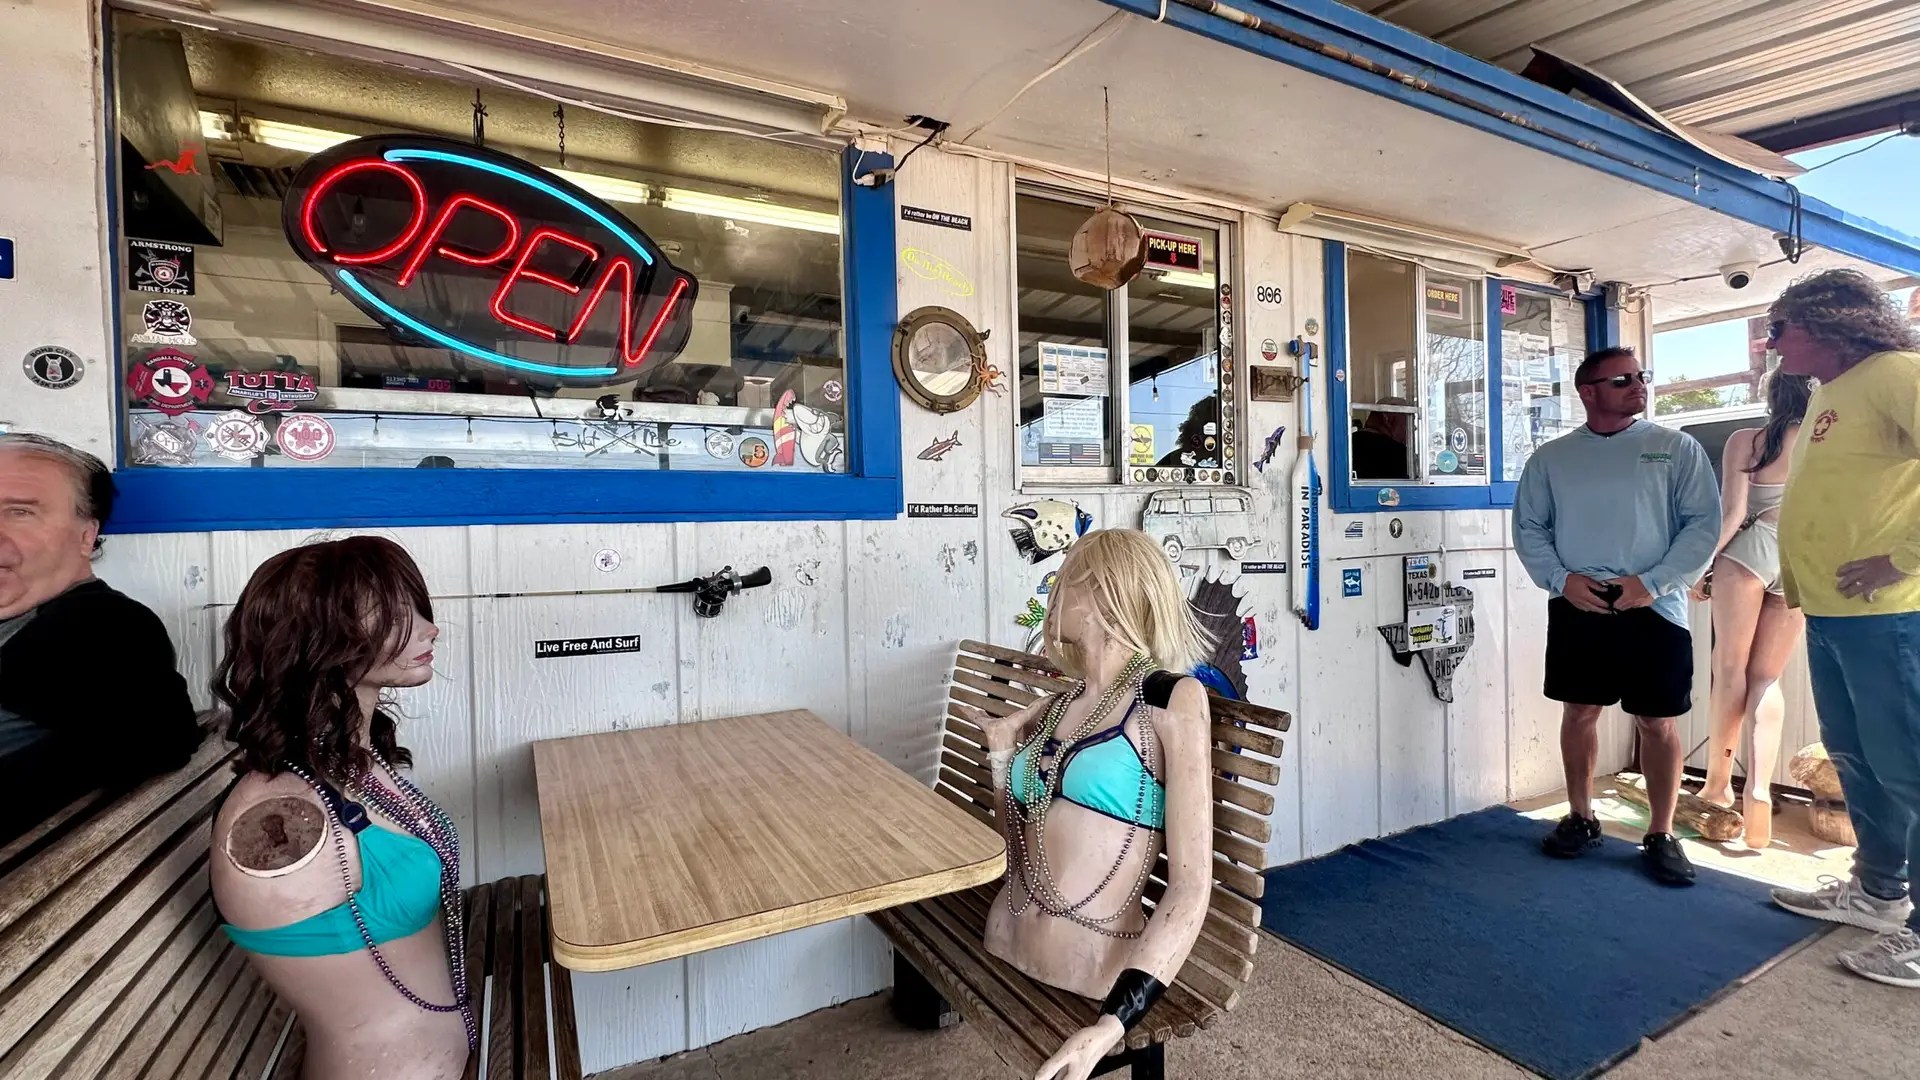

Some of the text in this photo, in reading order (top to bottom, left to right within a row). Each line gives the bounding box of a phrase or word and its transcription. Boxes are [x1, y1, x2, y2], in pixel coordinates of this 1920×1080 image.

[951, 217, 969, 225] BEACH
[130, 241, 192, 253] ARMSTRONG
[1149, 238, 1196, 255] PICK-UP HERE
[301, 156, 691, 368] OPEN
[138, 285, 188, 295] FIRE DEPT
[1257, 286, 1282, 304] 806
[1427, 289, 1458, 303] ORDER HERE
[30, 348, 74, 358] BOMB CITY
[146, 356, 196, 368] RANDALL COUNTY
[32, 376, 51, 387] TASK
[156, 433, 180, 450] CFD
[909, 505, 976, 514] I'd Rather Be Surfing
[1301, 486, 1311, 569] IN PARADISE
[1407, 558, 1428, 566] TEXAS
[1408, 571, 1427, 580] TEXAS
[537, 642, 560, 653] Live
[563, 641, 588, 651] Free
[590, 639, 612, 650] And
[615, 637, 639, 648] Surf
[1447, 646, 1465, 654] TEXAS
